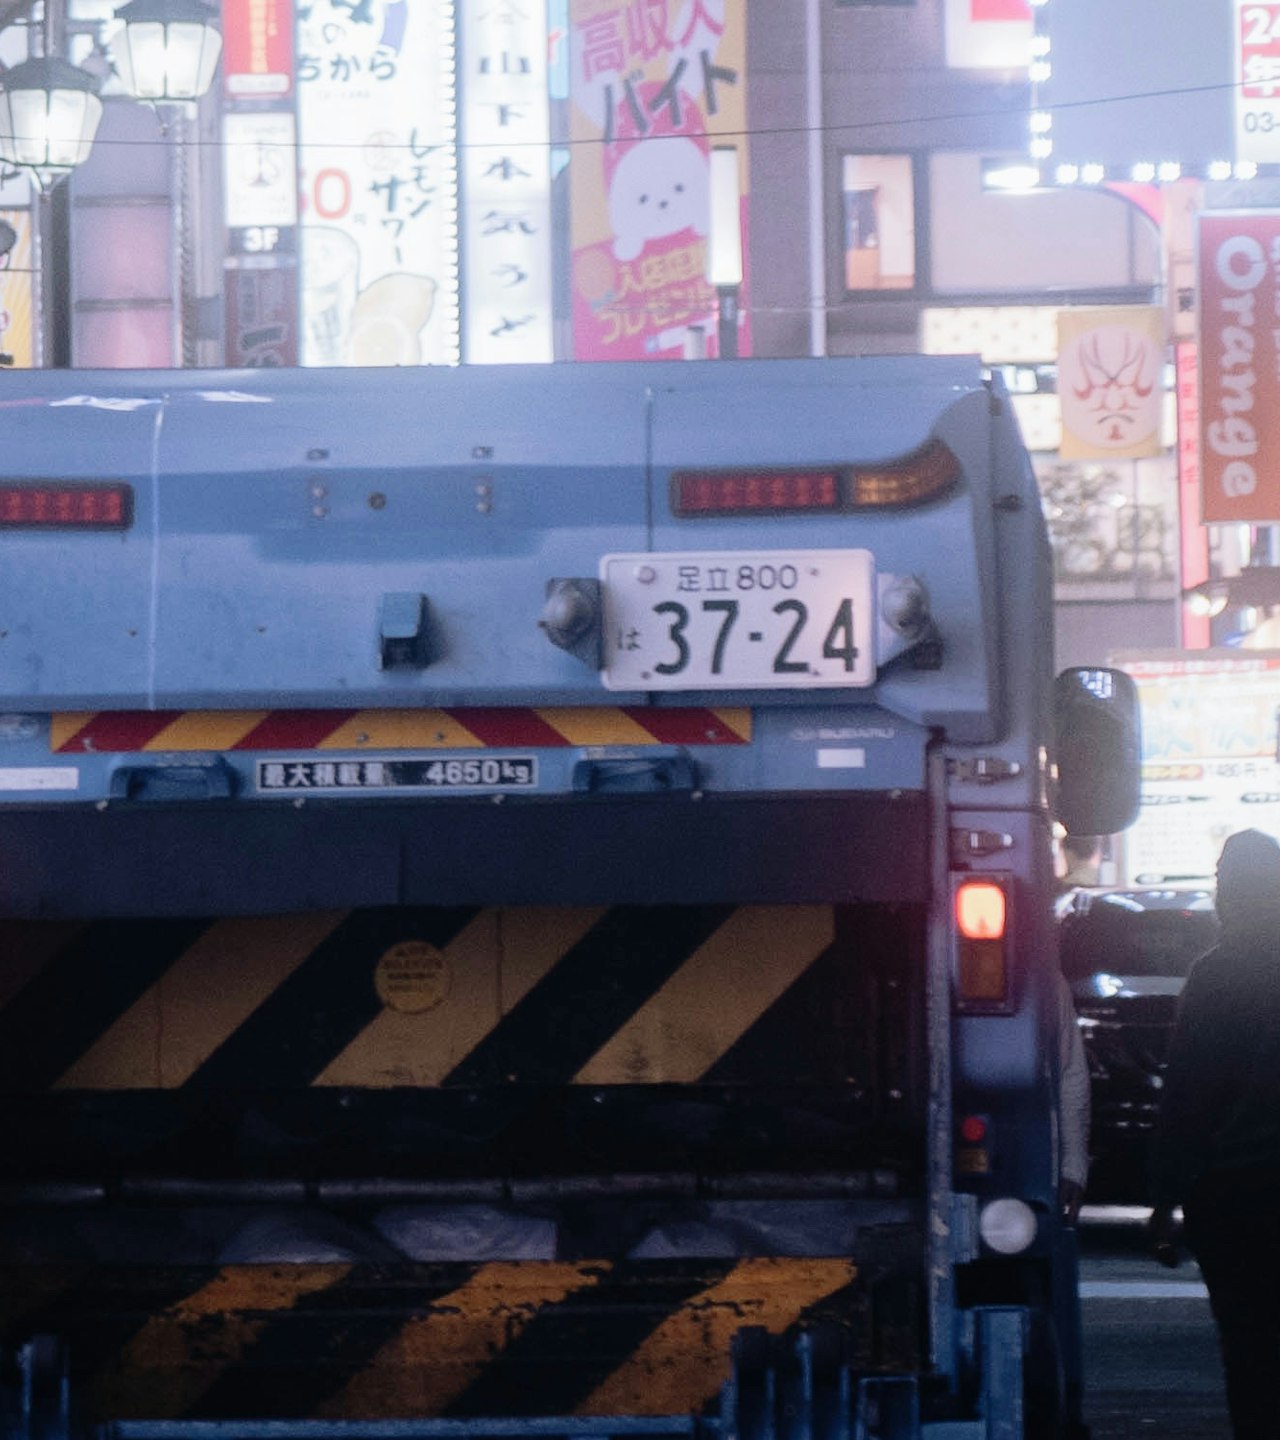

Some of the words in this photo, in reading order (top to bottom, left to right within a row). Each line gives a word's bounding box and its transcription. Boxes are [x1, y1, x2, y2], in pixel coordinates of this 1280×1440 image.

[604, 49, 738, 145] バイト
[243, 227, 279, 252] 3F
[1208, 234, 1268, 499] Orange
[677, 565, 736, 593] 足立
[740, 565, 798, 592] 800
[652, 596, 859, 675] 37-24
[263, 761, 385, 788] 最大積載量
[427, 759, 531, 788] 4650kg
